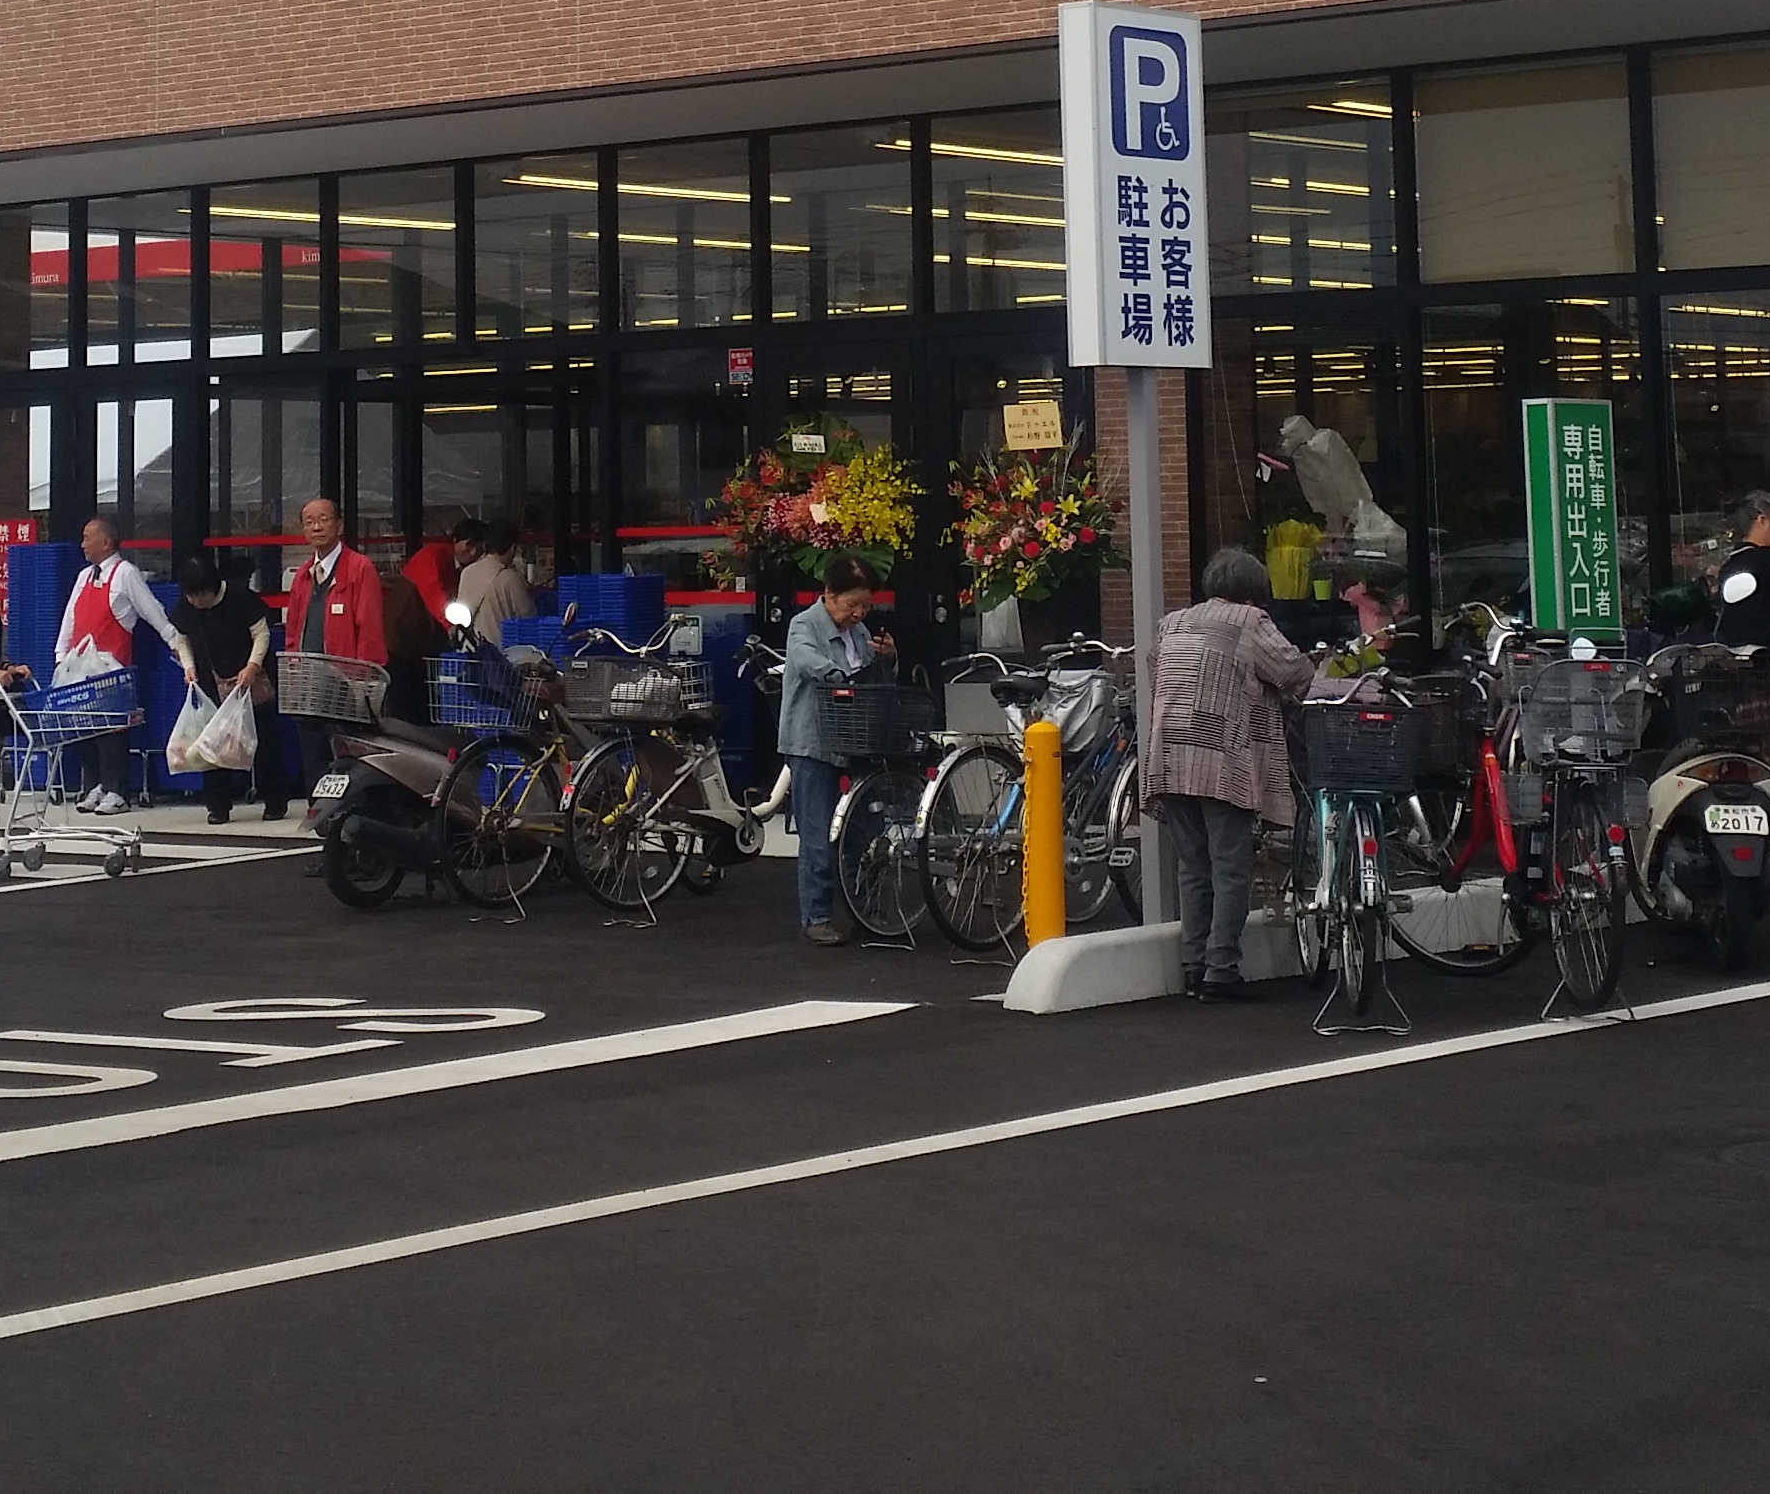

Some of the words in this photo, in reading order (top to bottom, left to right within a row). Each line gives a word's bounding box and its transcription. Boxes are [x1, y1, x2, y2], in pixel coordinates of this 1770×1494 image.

[1117, 175, 1153, 346] 駐車場
[1160, 178, 1195, 347] お客様
[1562, 424, 1591, 617] 専用出入口
[1721, 815, 1764, 832] 2017
